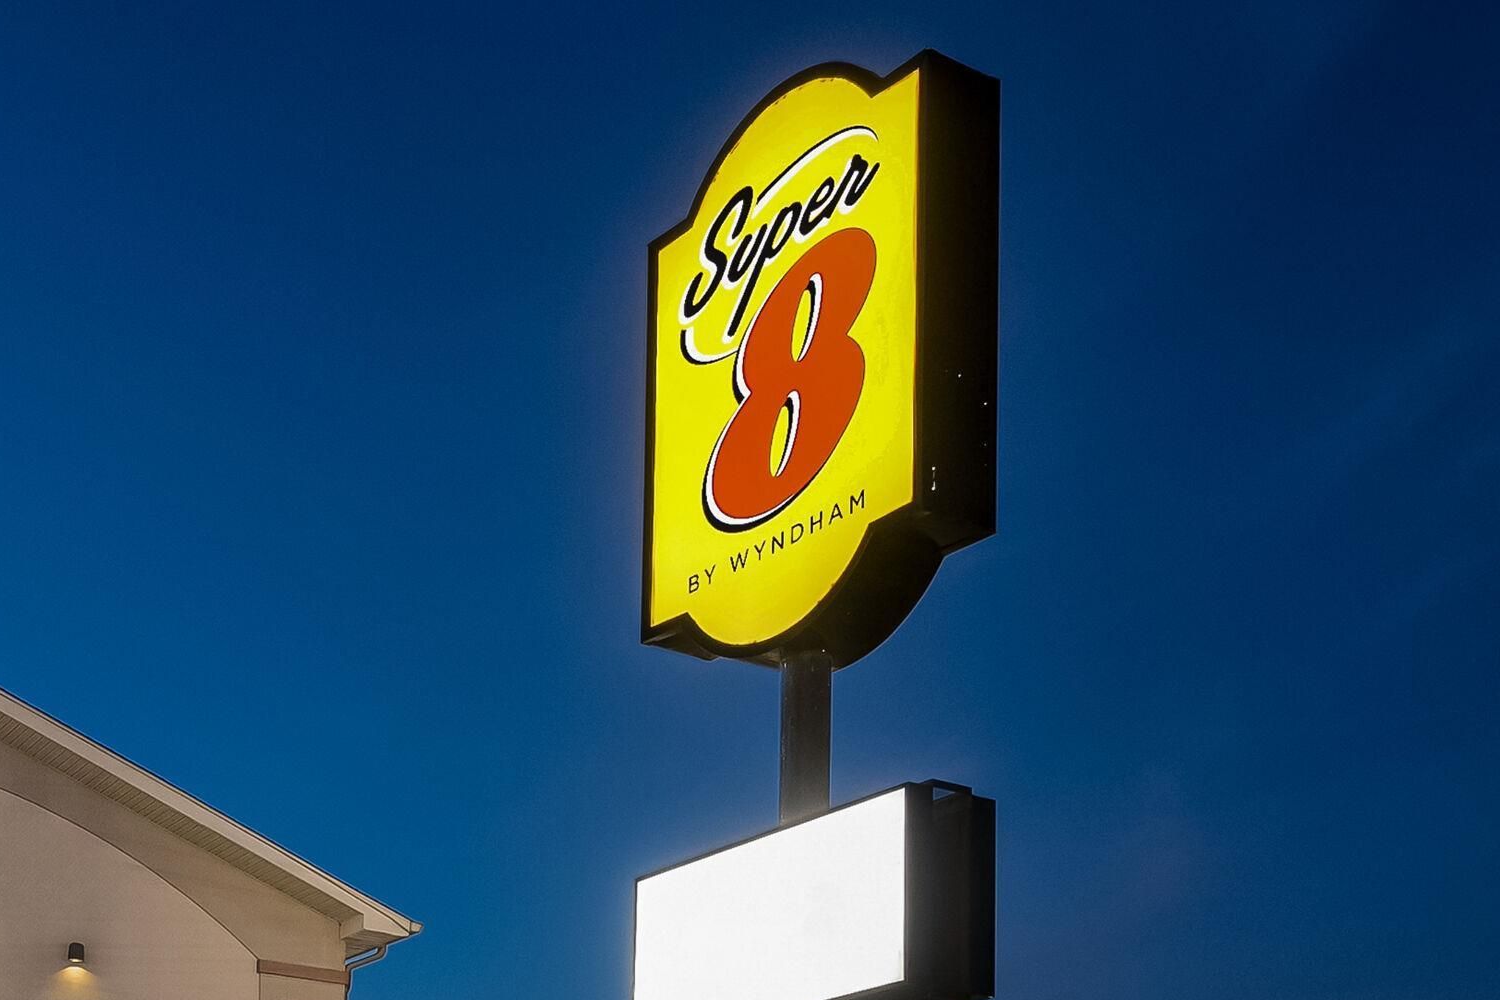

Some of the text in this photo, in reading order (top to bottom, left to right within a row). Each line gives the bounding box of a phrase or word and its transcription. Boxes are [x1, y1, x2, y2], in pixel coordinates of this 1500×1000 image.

[681, 153, 881, 344] Super
[702, 227, 877, 533] 8
[688, 489, 866, 594] BY WYNDHAM
